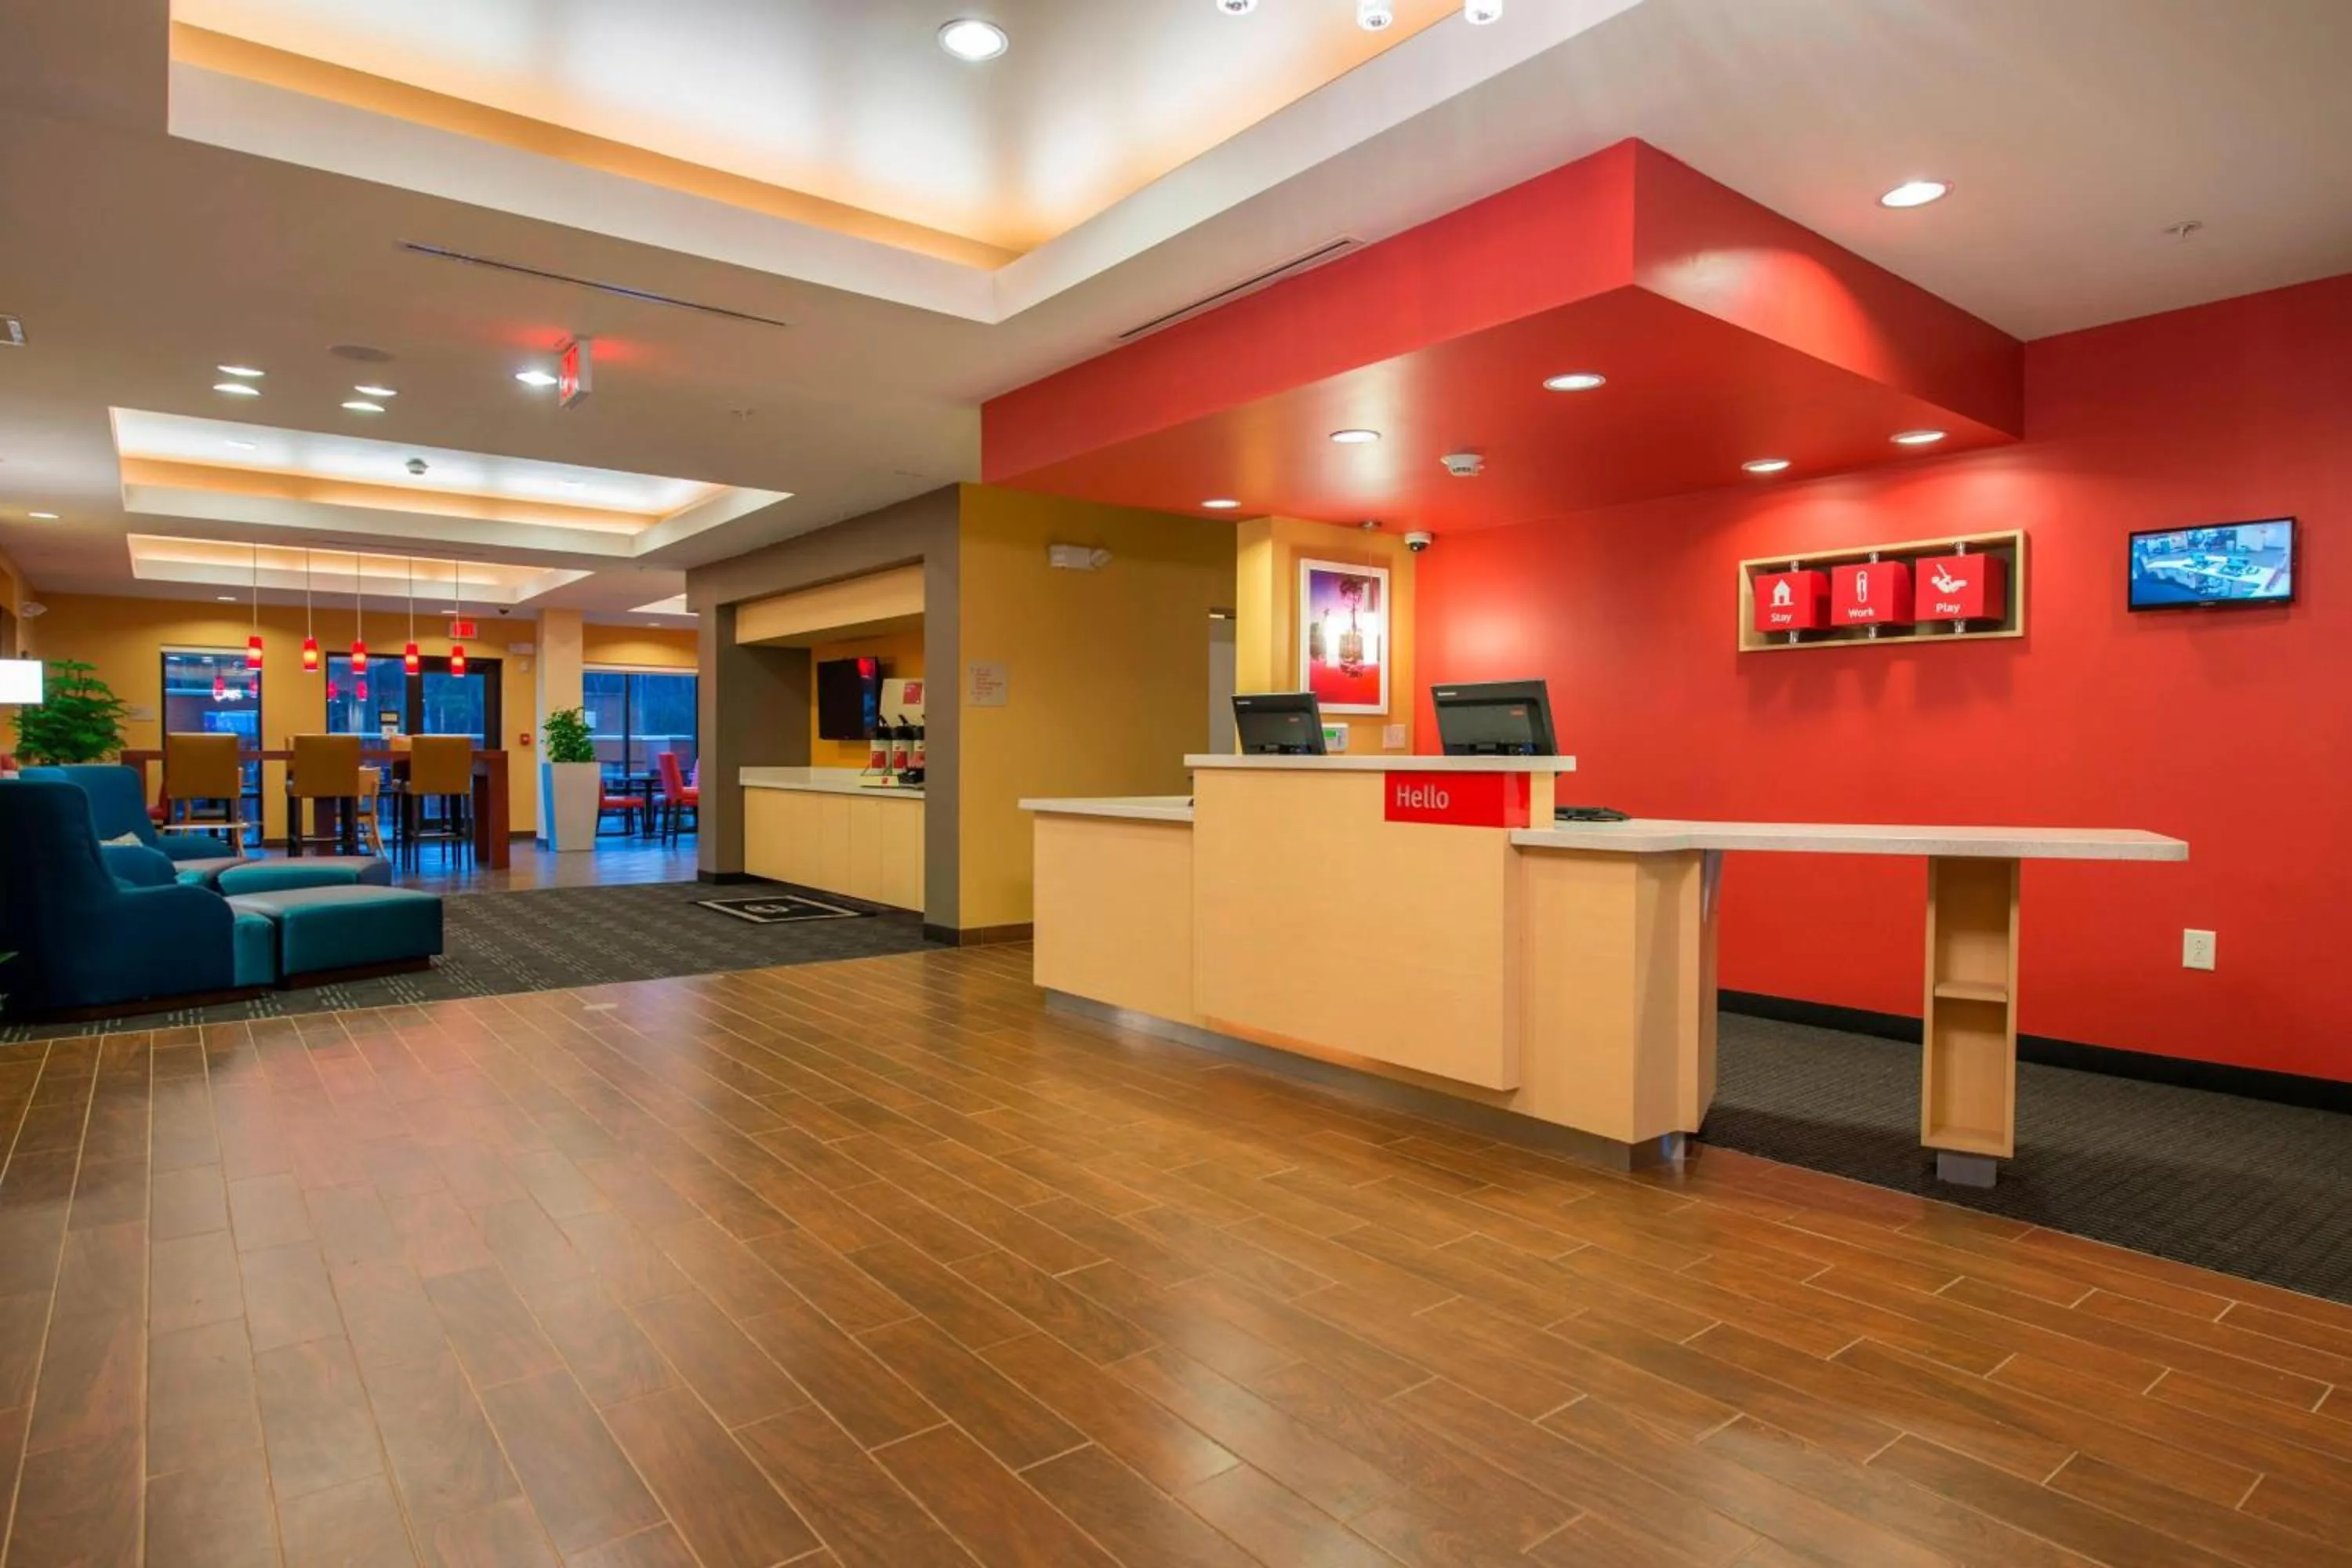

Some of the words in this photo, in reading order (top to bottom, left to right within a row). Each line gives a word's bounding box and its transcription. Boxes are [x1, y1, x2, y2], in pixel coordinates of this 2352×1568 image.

[1848, 607, 1875, 618] Work
[1936, 602, 1961, 614] Play
[1770, 612, 1792, 623] Stay
[1396, 784, 1450, 810] Hello
